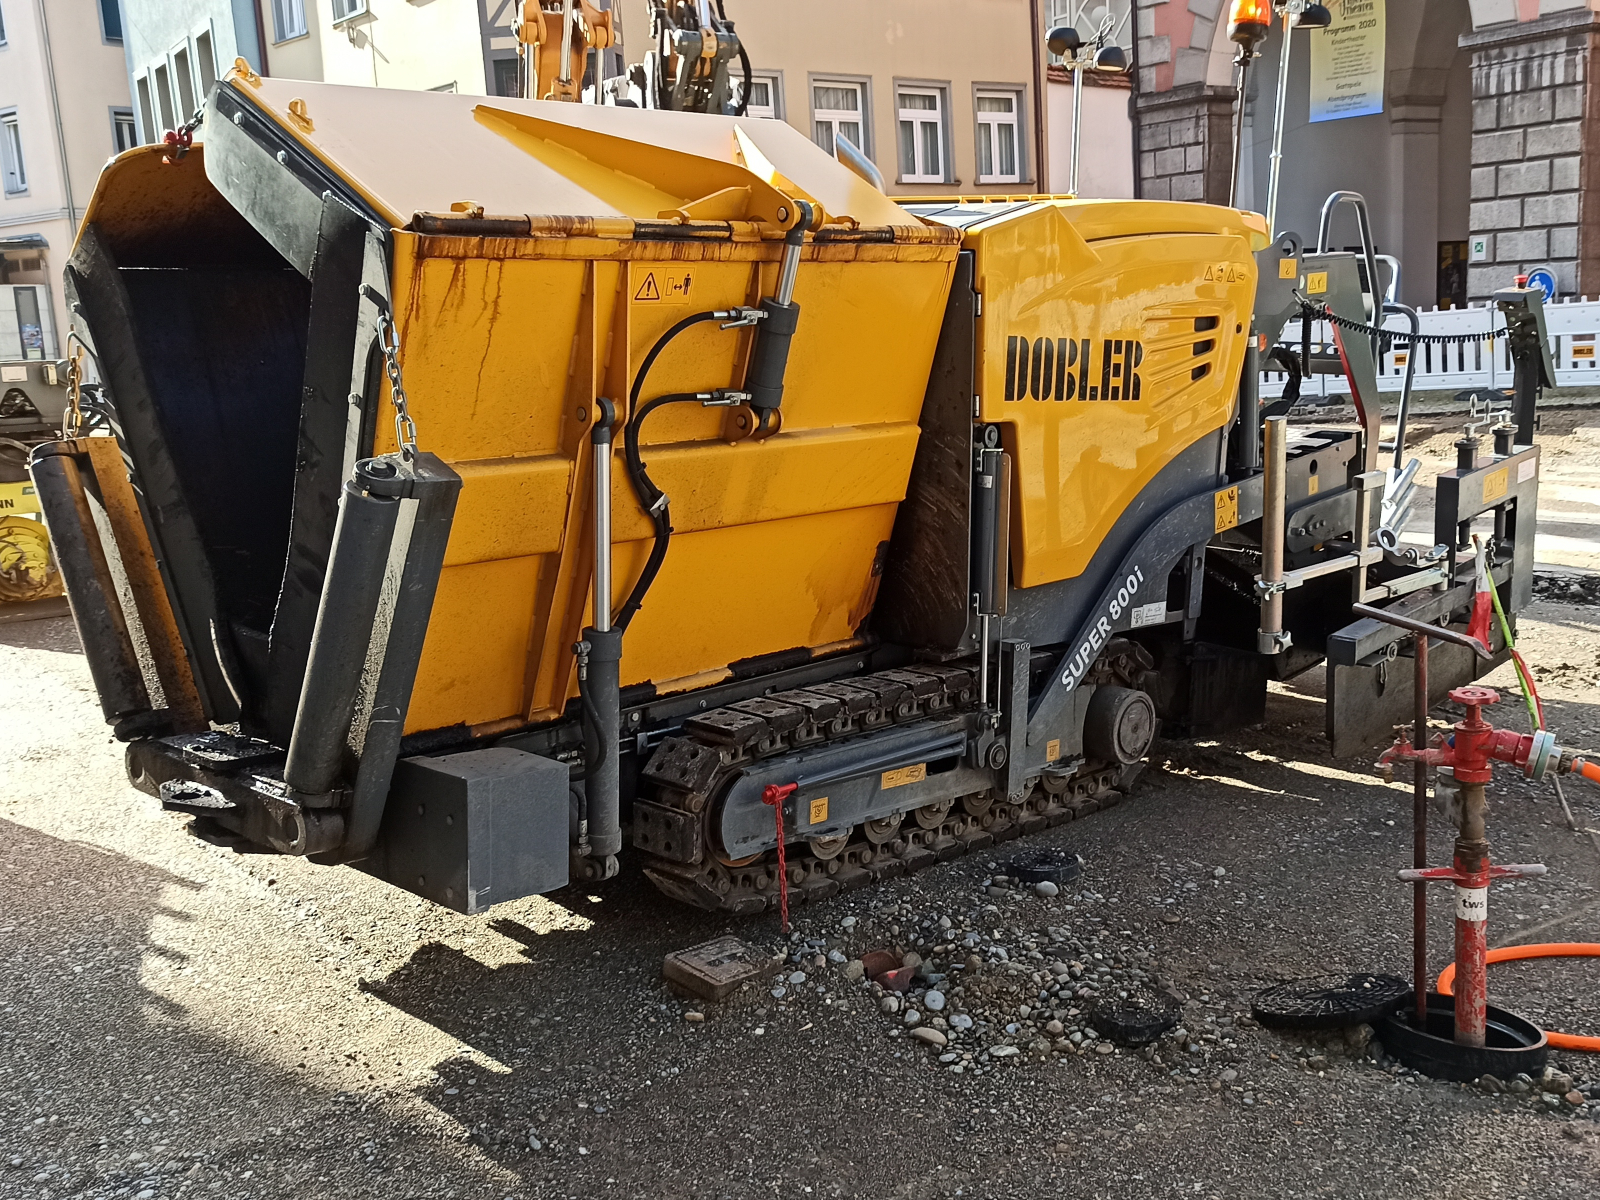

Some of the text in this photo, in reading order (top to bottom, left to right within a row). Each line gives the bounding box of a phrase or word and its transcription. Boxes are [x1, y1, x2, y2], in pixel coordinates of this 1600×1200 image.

[1323, 18, 1377, 37] Programm 2020
[1331, 35, 1367, 46] Kindertheater
[1004, 335, 1143, 401] DOBLER
[1061, 565, 1144, 692] SUPER 800i
[1462, 898, 1485, 909] tws
